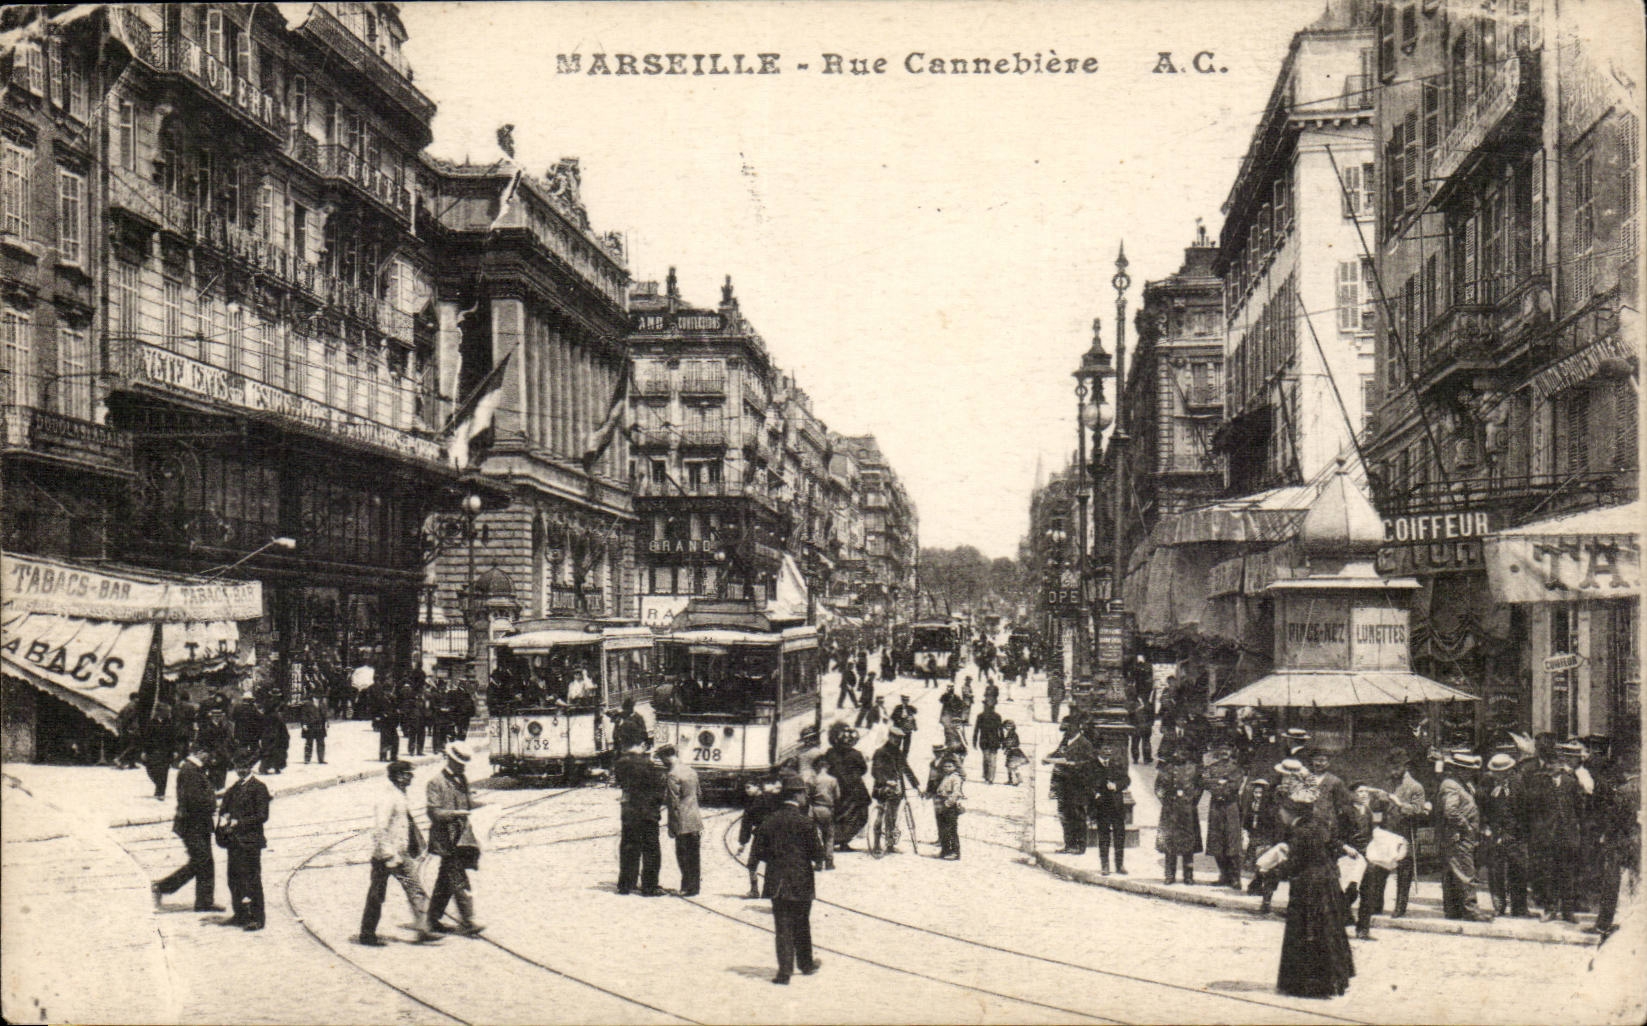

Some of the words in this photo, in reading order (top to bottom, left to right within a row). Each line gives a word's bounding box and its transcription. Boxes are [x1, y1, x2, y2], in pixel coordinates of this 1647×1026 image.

[190, 42, 273, 126] MODERN
[1383, 512, 1490, 542] COIFFEUR
[10, 563, 131, 600] TABACS-BAR
[1356, 623, 1406, 644] LUNETTES
[693, 748, 722, 762] 708
